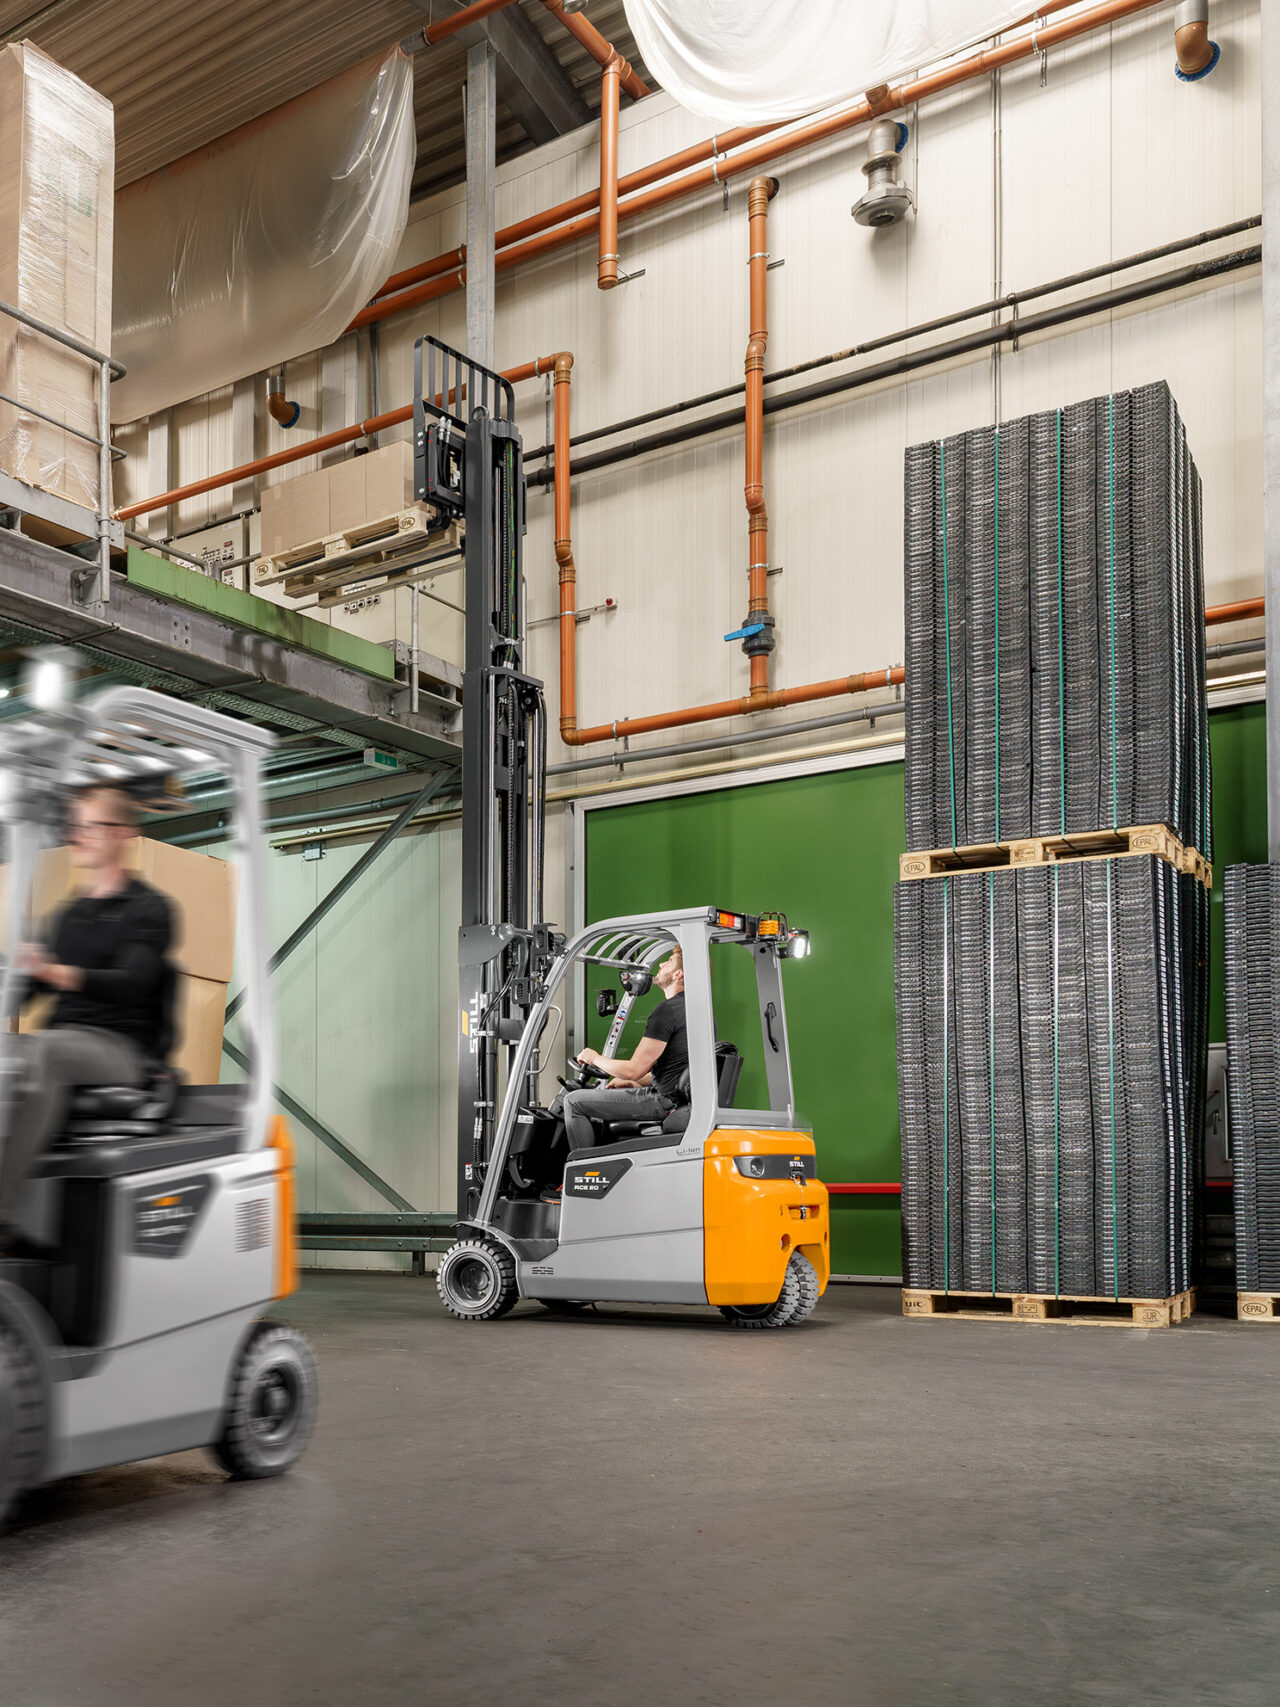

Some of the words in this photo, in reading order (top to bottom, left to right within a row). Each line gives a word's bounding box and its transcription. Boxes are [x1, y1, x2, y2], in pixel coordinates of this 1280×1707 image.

[1135, 838, 1152, 847] EPAL
[469, 991, 479, 1053] STILL
[574, 1176, 610, 1184] STILL
